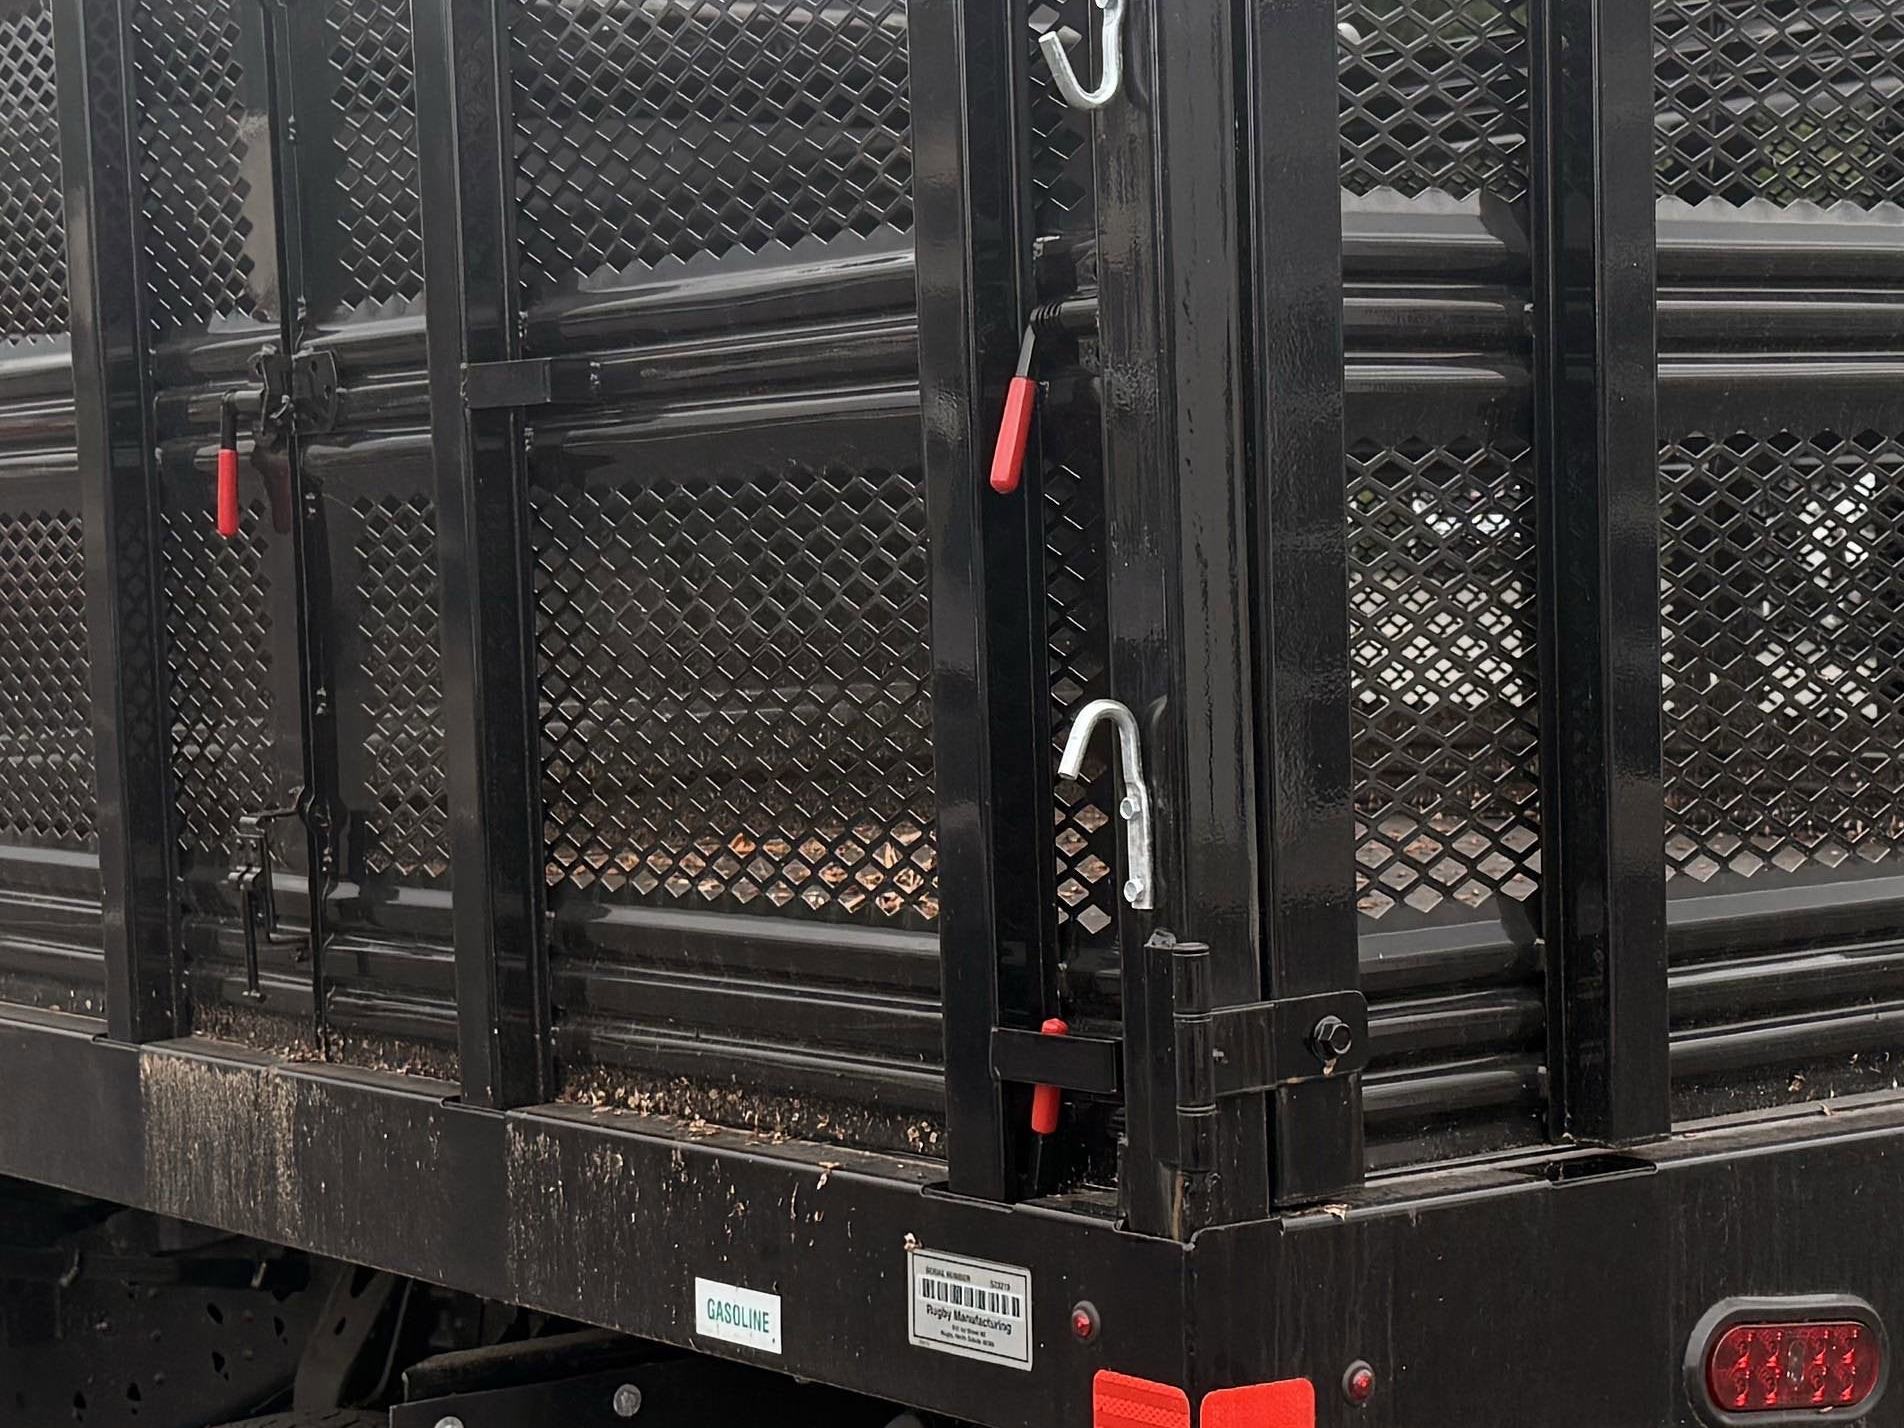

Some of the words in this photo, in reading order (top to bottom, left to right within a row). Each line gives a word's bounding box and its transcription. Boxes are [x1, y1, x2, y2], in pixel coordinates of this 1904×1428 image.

[707, 1298, 769, 1333] GASOLINE
[926, 1304, 953, 1322] Rugby
[953, 1309, 1013, 1336] Manufacturing
